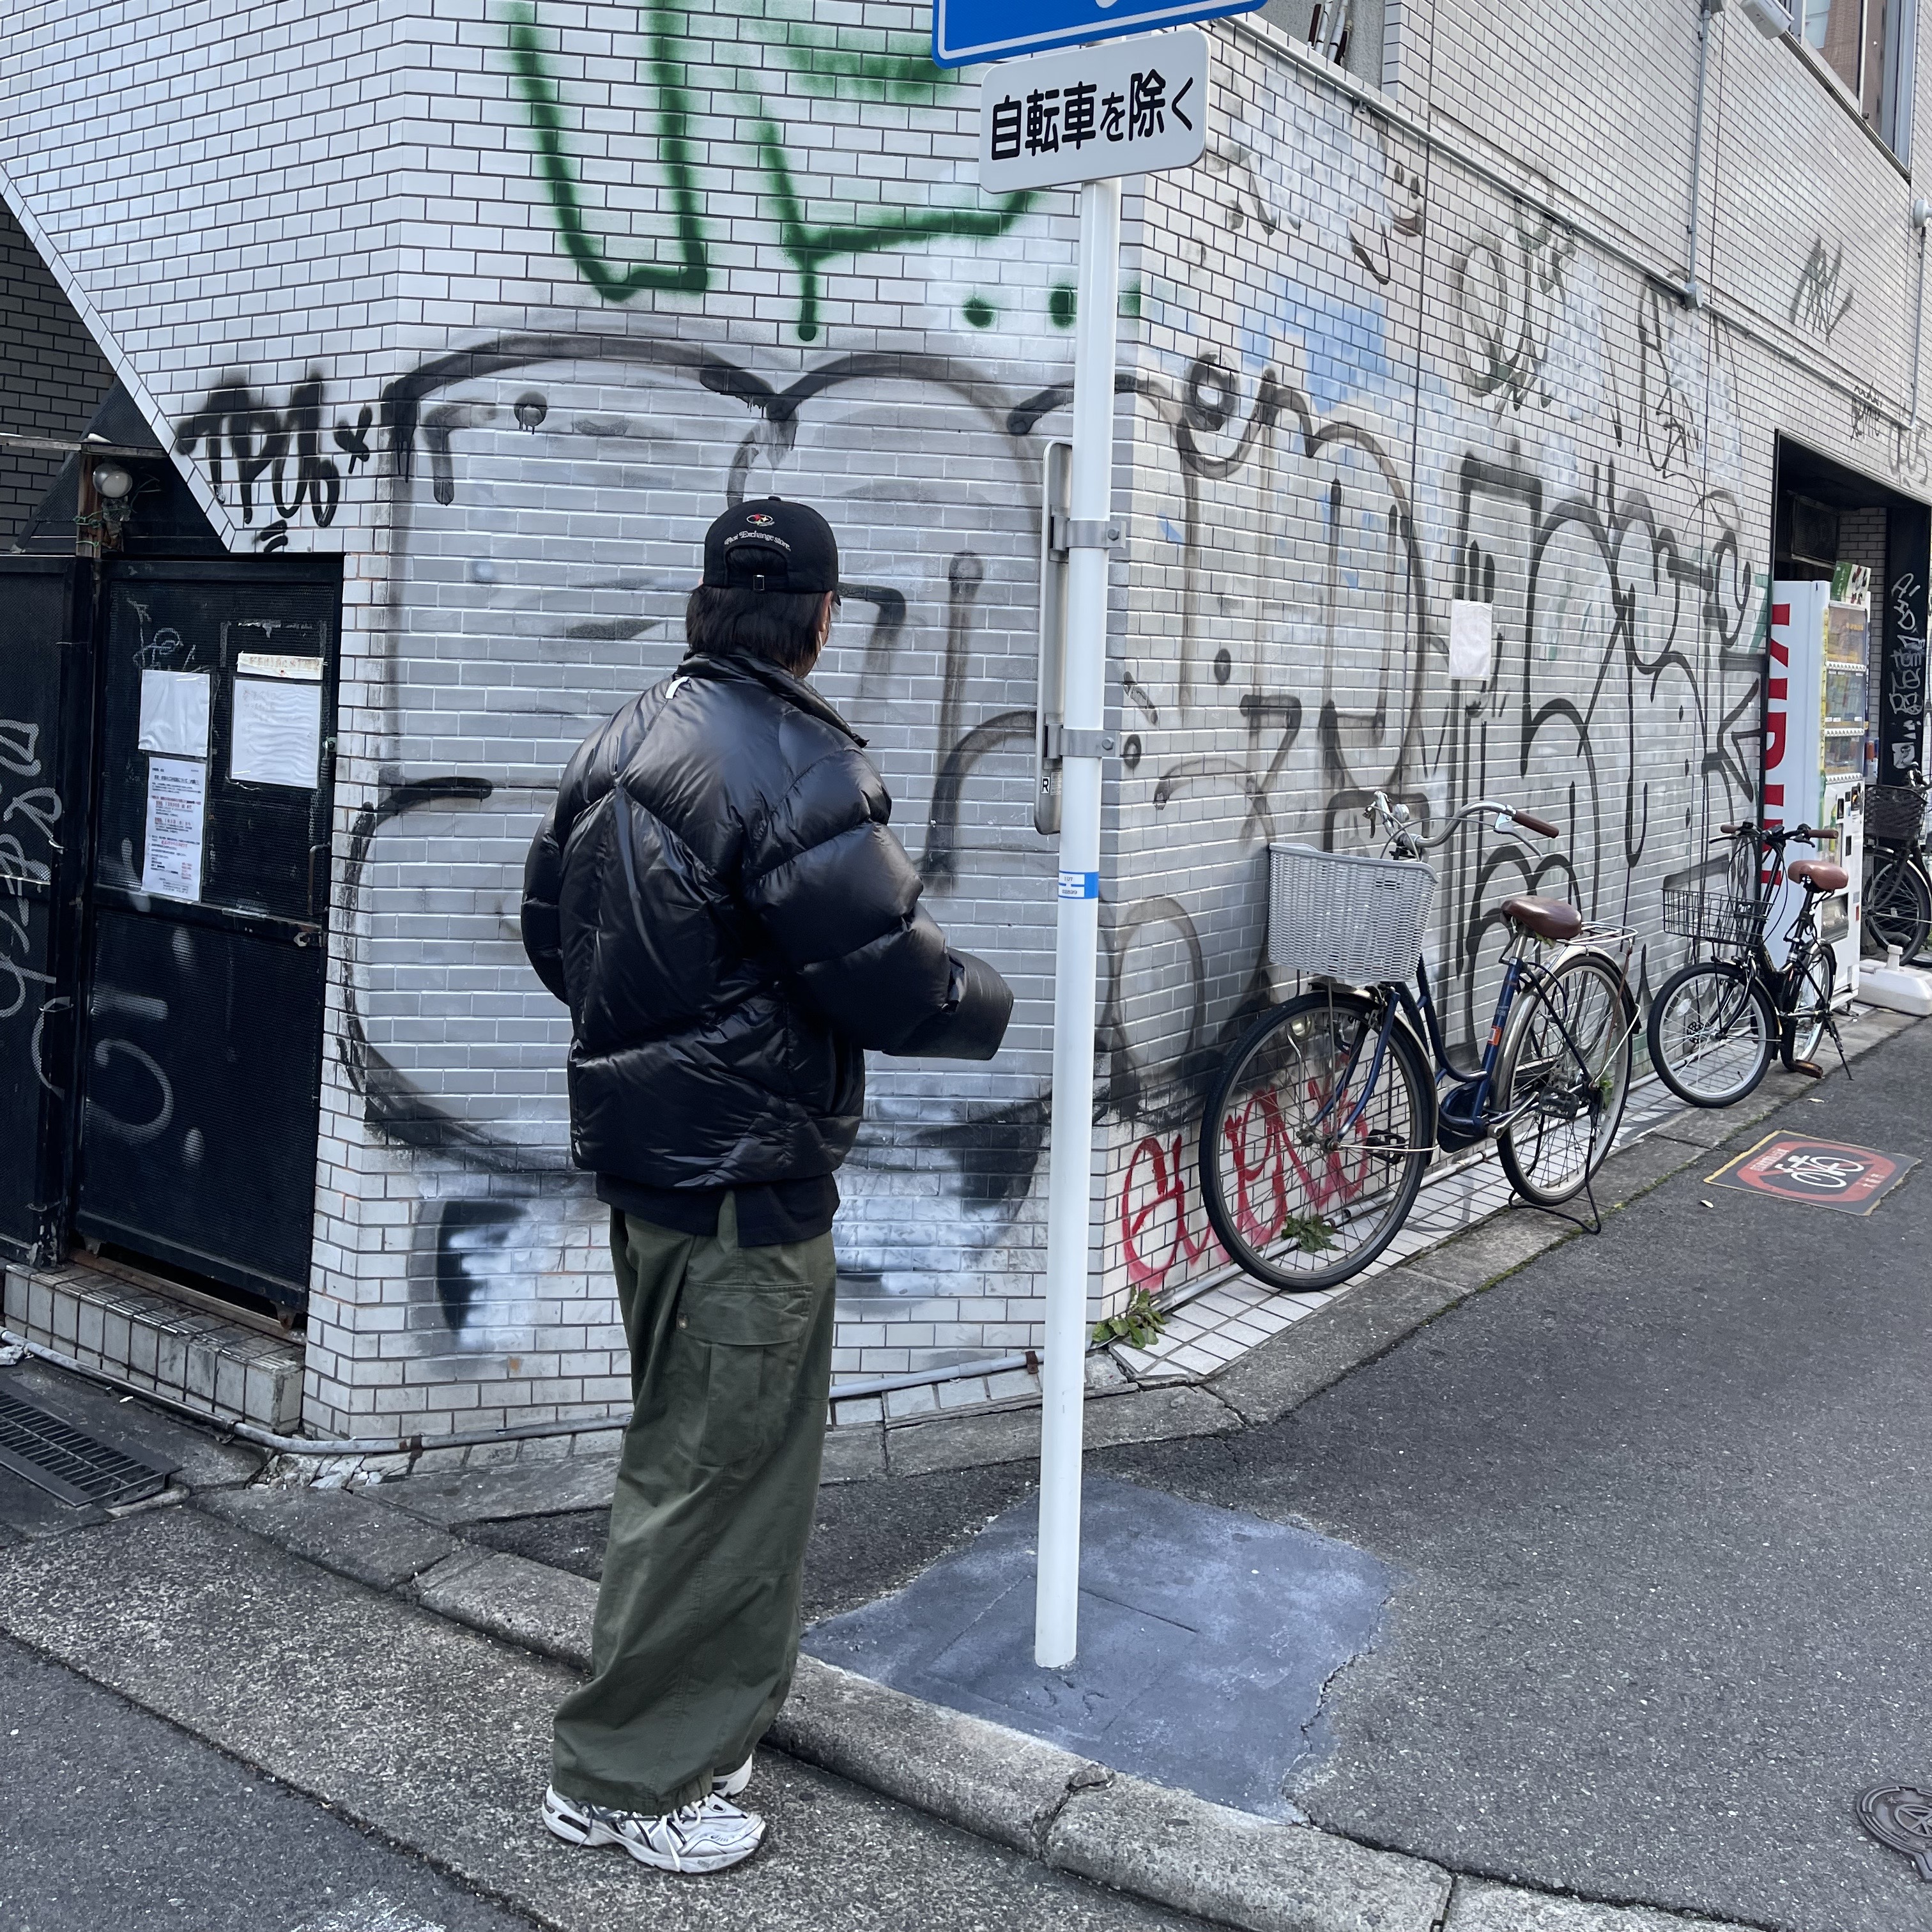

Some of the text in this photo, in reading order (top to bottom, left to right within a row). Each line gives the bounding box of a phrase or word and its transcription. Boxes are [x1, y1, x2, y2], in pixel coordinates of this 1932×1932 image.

[990, 68, 1194, 161] 自転車を除く
[1042, 778, 1049, 792] R
